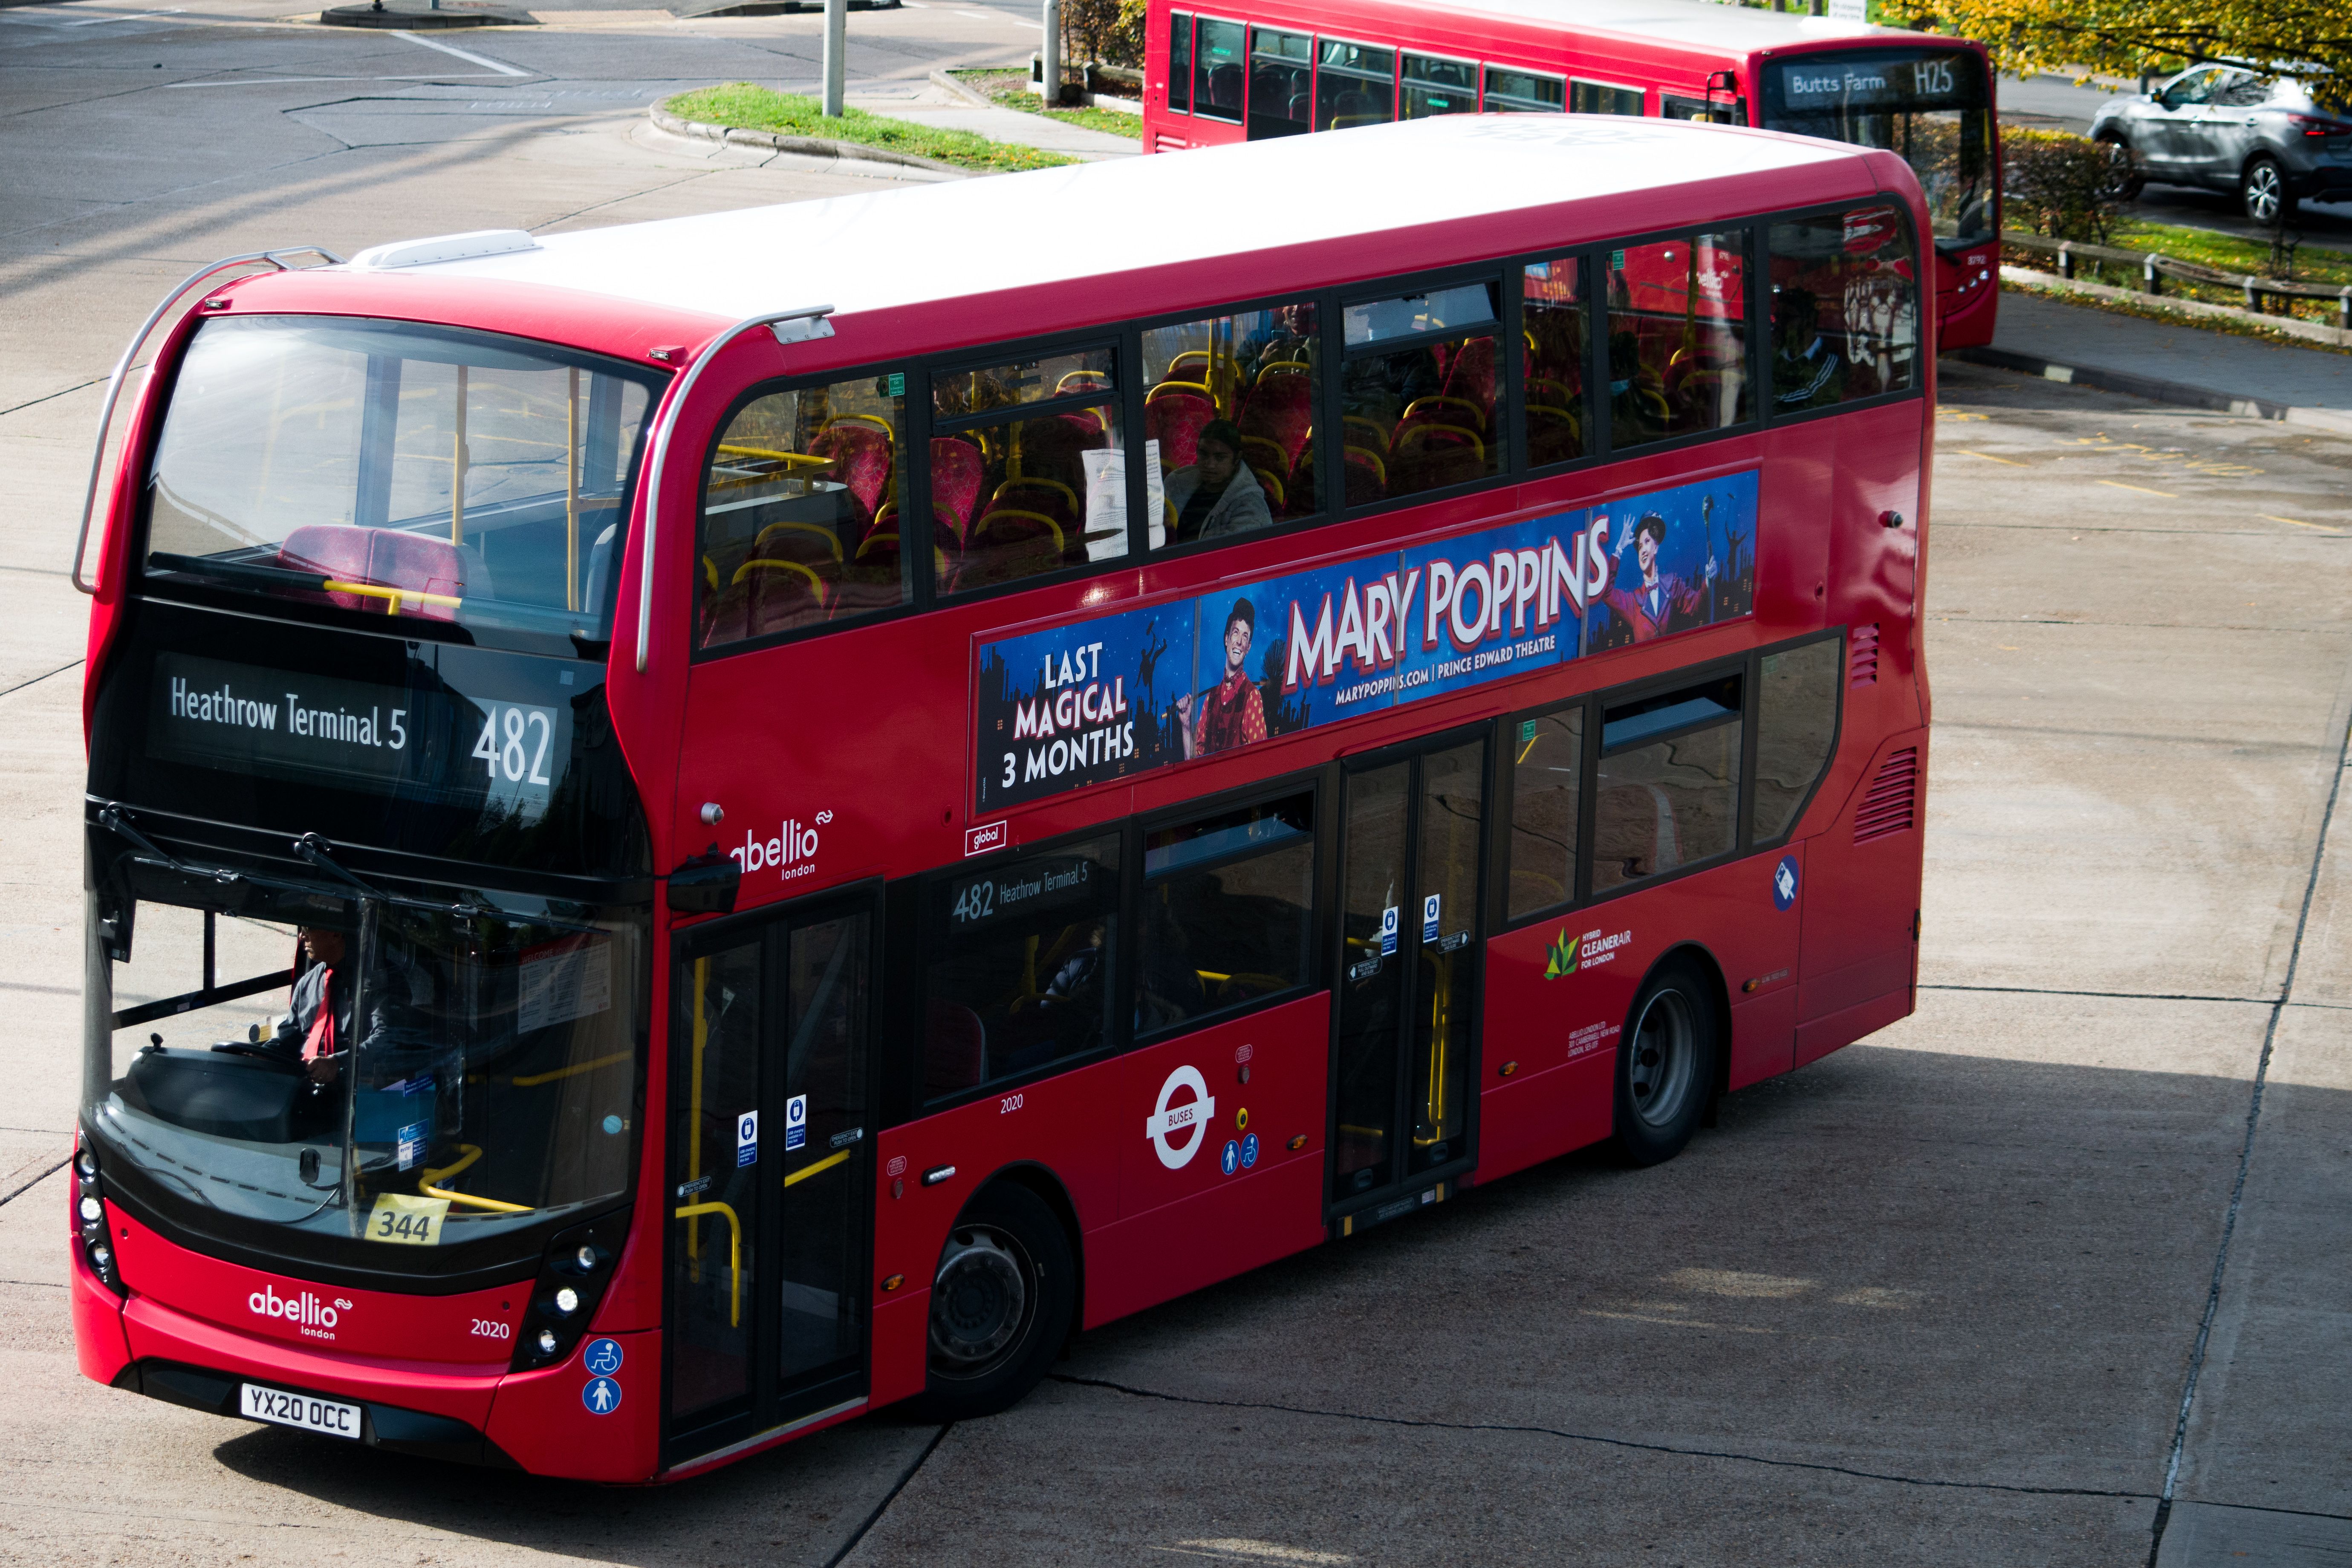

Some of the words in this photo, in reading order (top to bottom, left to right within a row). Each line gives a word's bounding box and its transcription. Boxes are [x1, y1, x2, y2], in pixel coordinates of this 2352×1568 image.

[1793, 76, 1840, 93] Butts
[1844, 72, 1887, 91] Farm
[1913, 61, 1954, 95] H25
[1286, 570, 1420, 685] MARY
[1427, 515, 1609, 644] POPPINS
[1045, 642, 1103, 690] LAST
[1438, 657, 1472, 679] PRINCE
[1474, 646, 1513, 670] EDWARD
[1515, 635, 1555, 658] THEATRE
[172, 677, 277, 731] Heathrow
[286, 693, 382, 748] Terminal
[388, 709, 407, 750] 5
[1013, 677, 1127, 739] MAGICAL
[472, 705, 550, 785] 482
[1002, 752, 1016, 788] 3
[1024, 721, 1134, 783] MONTHS
[974, 826, 998, 850] global
[782, 863, 815, 881] london
[953, 881, 994, 922] 482
[1000, 879, 1041, 904] Heathrow
[1044, 863, 1079, 892] Terminal
[1081, 861, 1088, 881] 5
[1581, 930, 1631, 958] CLEANERAIR
[1582, 929, 1601, 941] HYBRID
[522, 948, 554, 964] WELCOME
[1581, 960, 1592, 970] FOR
[1592, 952, 1615, 967] LONDON
[1001, 1094, 1023, 1114] 2020
[1168, 1108, 1193, 1126] BUSES
[832, 1132, 850, 1141] EMERGENCY
[684, 1181, 702, 1189] EMERGENCY
[378, 1211, 430, 1242] 344
[249, 1285, 338, 1328] abellio
[301, 1325, 335, 1340] london
[471, 1318, 510, 1339] 2020
[251, 1389, 303, 1421] YX20
[310, 1402, 350, 1431] OCC
